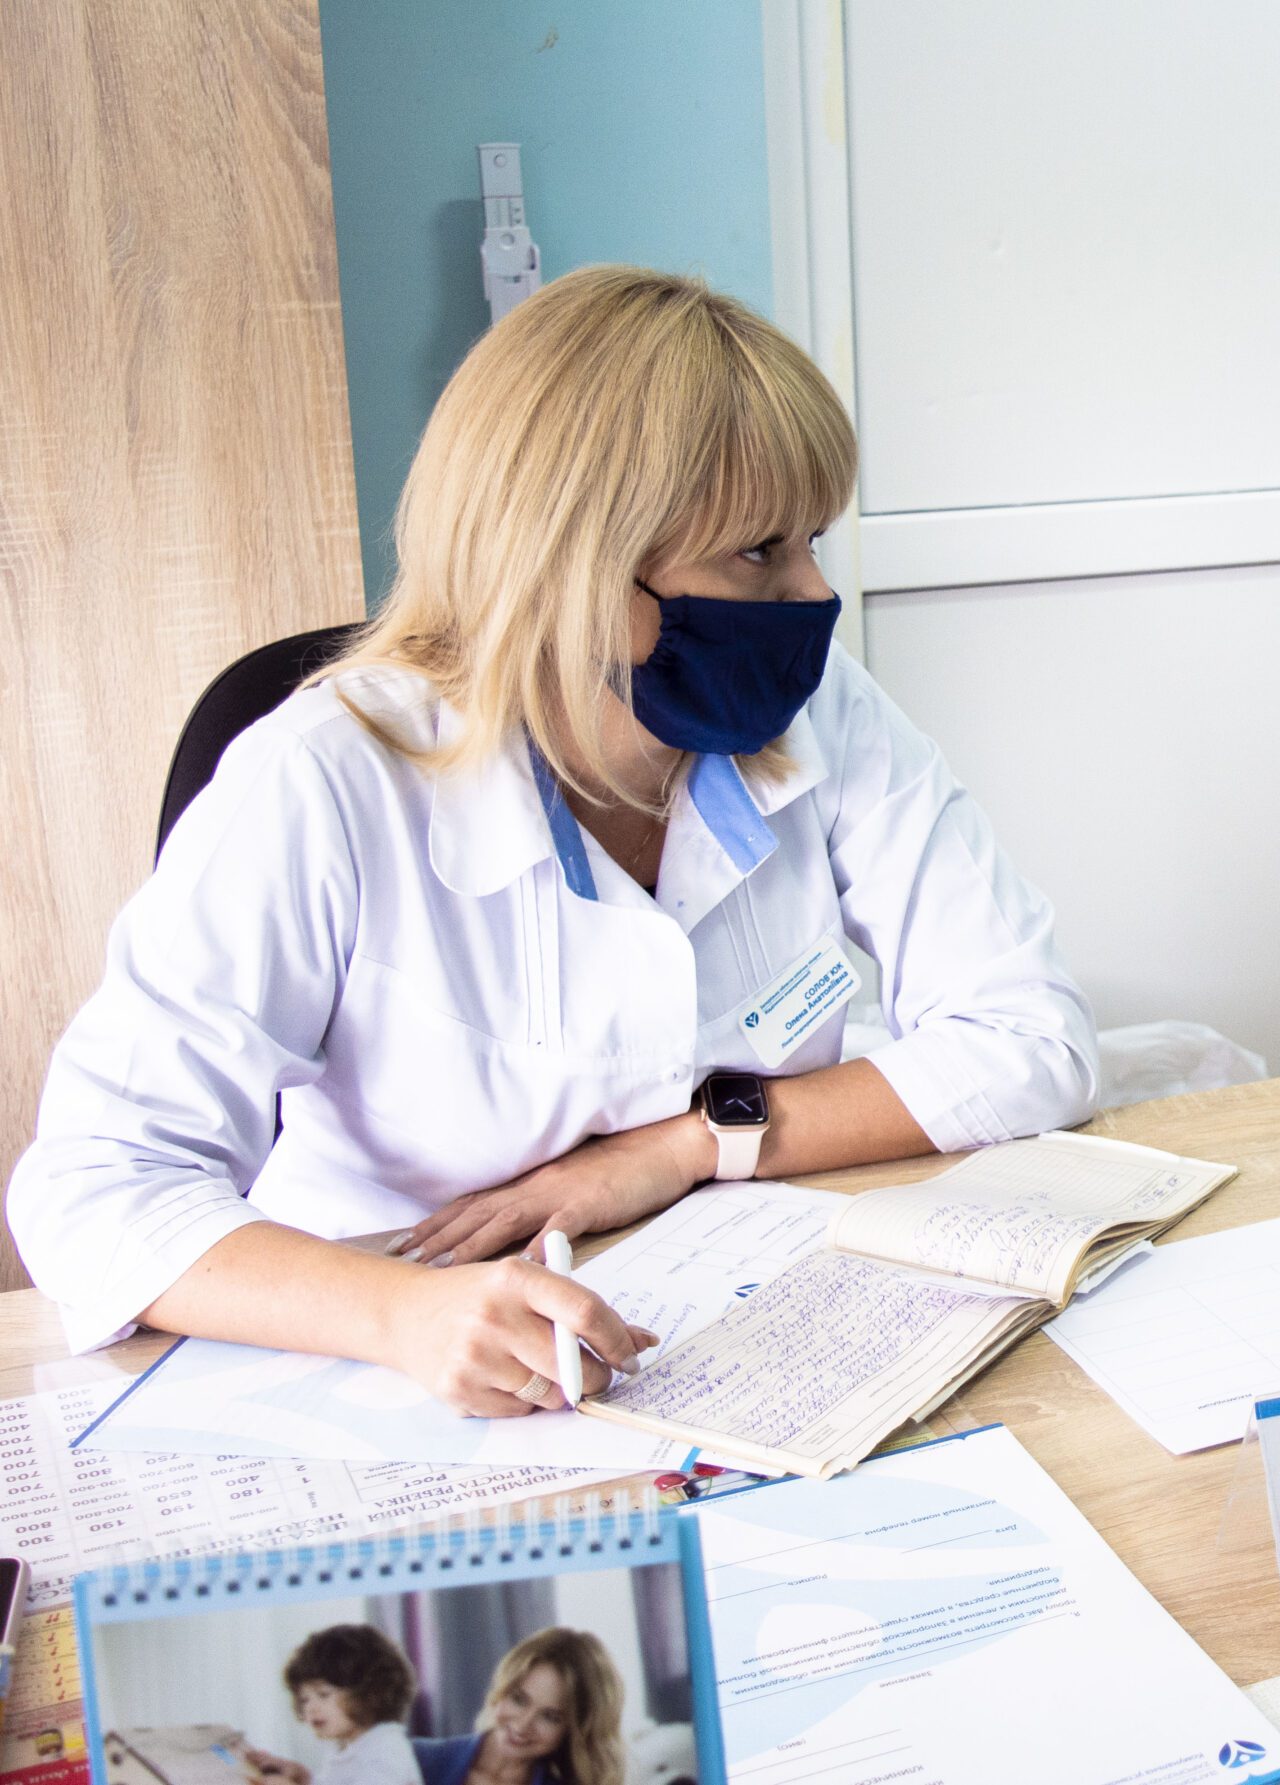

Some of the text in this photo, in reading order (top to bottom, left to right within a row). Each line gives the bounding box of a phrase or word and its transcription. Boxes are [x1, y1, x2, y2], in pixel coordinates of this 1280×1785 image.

[784, 969, 849, 1030] Олена Анатоліївна
[0, 1400, 25, 1412] 35
[0, 1420, 93, 1447] 50 700
[0, 1445, 35, 1459] 700
[2, 1457, 37, 1471] 700
[4, 1454, 108, 1483] 700 700
[75, 1466, 112, 1481] 800
[209, 1458, 266, 1477] 600-700
[518, 1467, 531, 1476] И
[6, 1481, 43, 1496] 700
[402, 1472, 447, 1489] Рост
[457, 1470, 514, 1490] РОСТА
[491, 1471, 557, 1494] НОРМЫ
[14, 1463, 306, 1535] 2 400 650 700-800 800
[71, 1488, 130, 1508] 700-800
[366, 1487, 487, 1523] НАРАСТАНИЯ
[373, 1484, 454, 1509] РЕБЕНКА
[0, 1504, 60, 1523] 700-800
[16, 1475, 311, 1548] 1 180 190 190 300
[910, 1511, 940, 1525] номер
[864, 1519, 909, 1537] телефона
[995, 1523, 1017, 1534] Дата
[986, 1565, 1049, 1587] предприятия.
[1002, 1576, 1059, 1597] бюджетные
[954, 1591, 1000, 1609] средства,
[1007, 1587, 1066, 1608] диагностики
[910, 1606, 944, 1621] рамках
[958, 1607, 996, 1621] лечения
[1026, 1607, 1042, 1616] Вас
[830, 1616, 908, 1642] существующего
[881, 1619, 946, 1643] Запорожской
[963, 1612, 1024, 1634] рассмотреть
[827, 1638, 880, 1658] областной
[896, 1630, 962, 1652] возможность
[741, 1637, 829, 1666] финансирования
[833, 1648, 894, 1669] проведения
[759, 1653, 824, 1675] клинической
[811, 1665, 830, 1674] мне
[718, 1671, 756, 1686] больни
